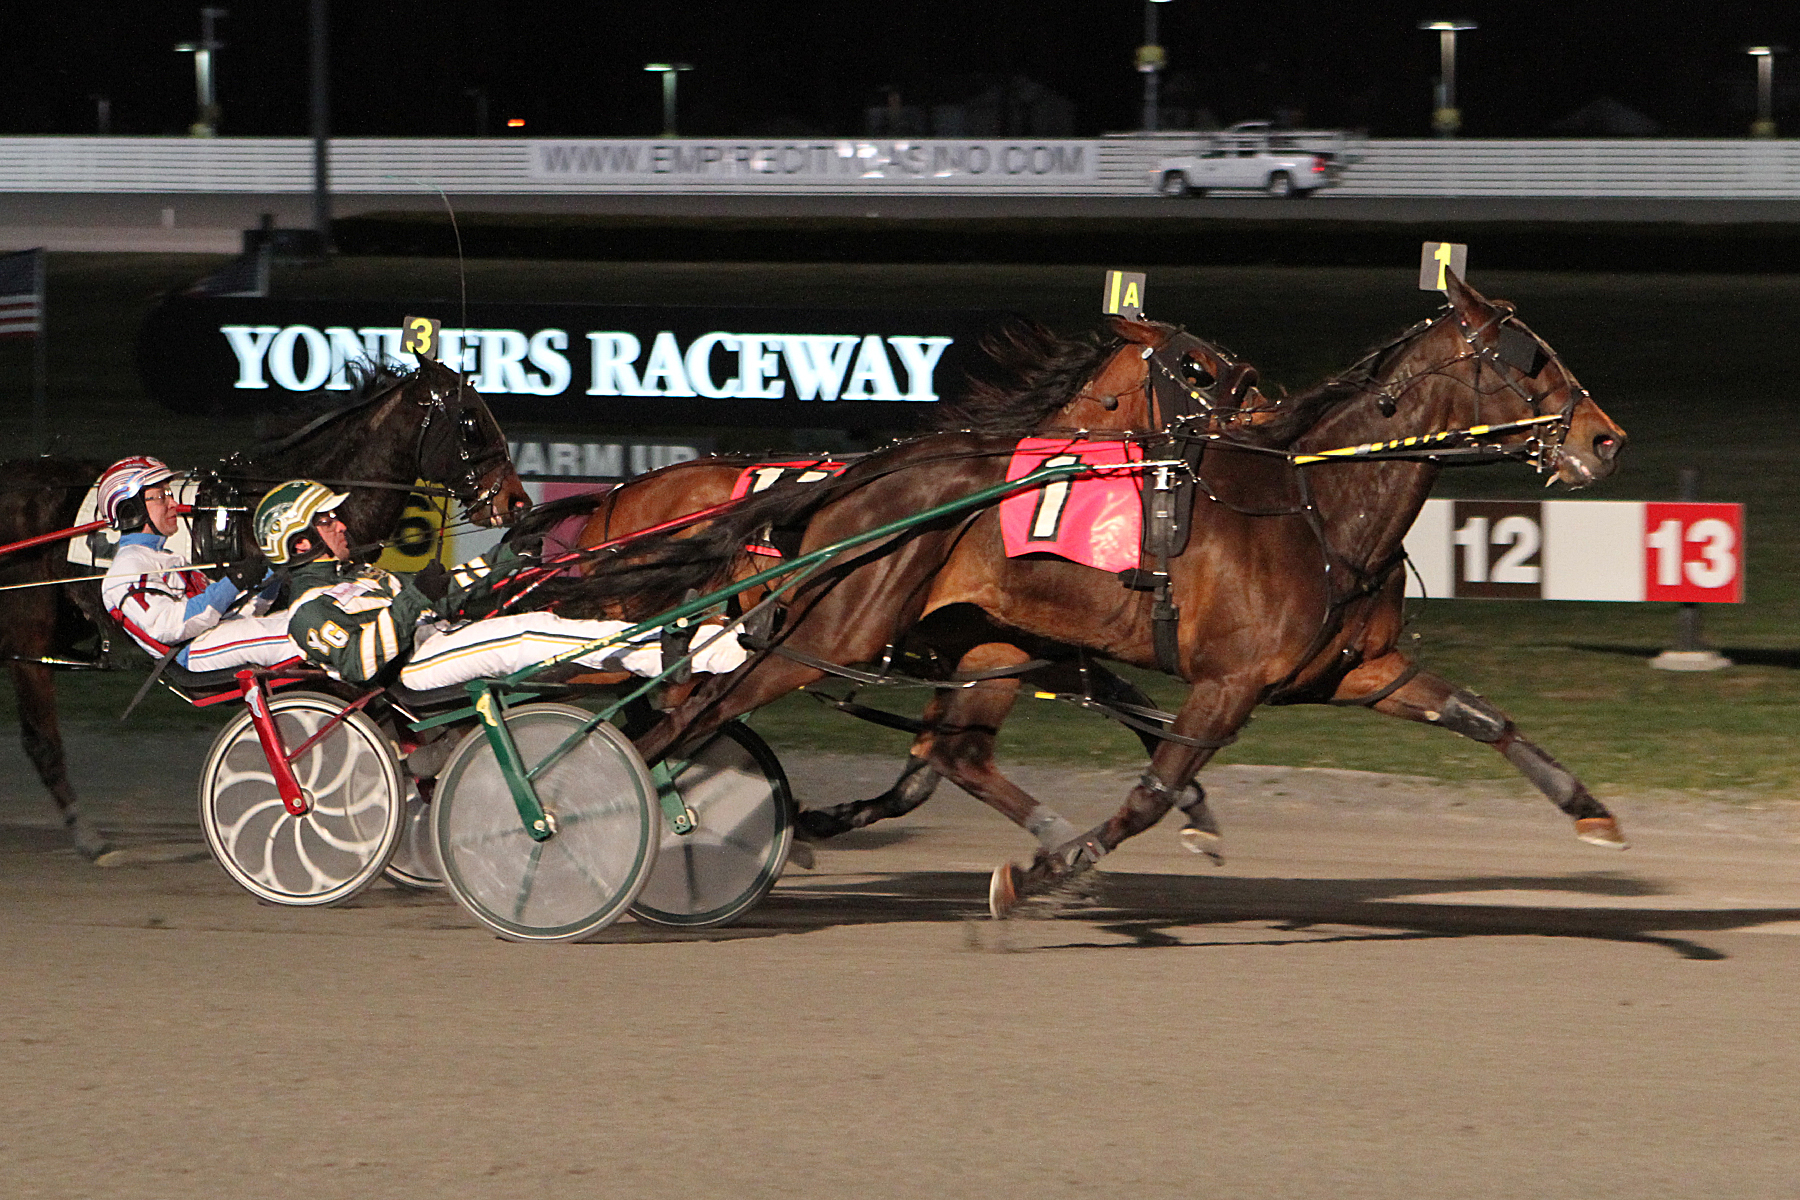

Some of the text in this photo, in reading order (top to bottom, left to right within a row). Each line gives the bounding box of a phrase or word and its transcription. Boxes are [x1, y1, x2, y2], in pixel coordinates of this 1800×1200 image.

[1434, 242, 1451, 291] 1
[405, 317, 433, 355] 3
[585, 331, 954, 401] RACEWAY
[507, 443, 623, 477] ARM
[1032, 454, 1077, 538] 1
[1452, 515, 1541, 583] 12
[1646, 517, 1738, 588] 13
